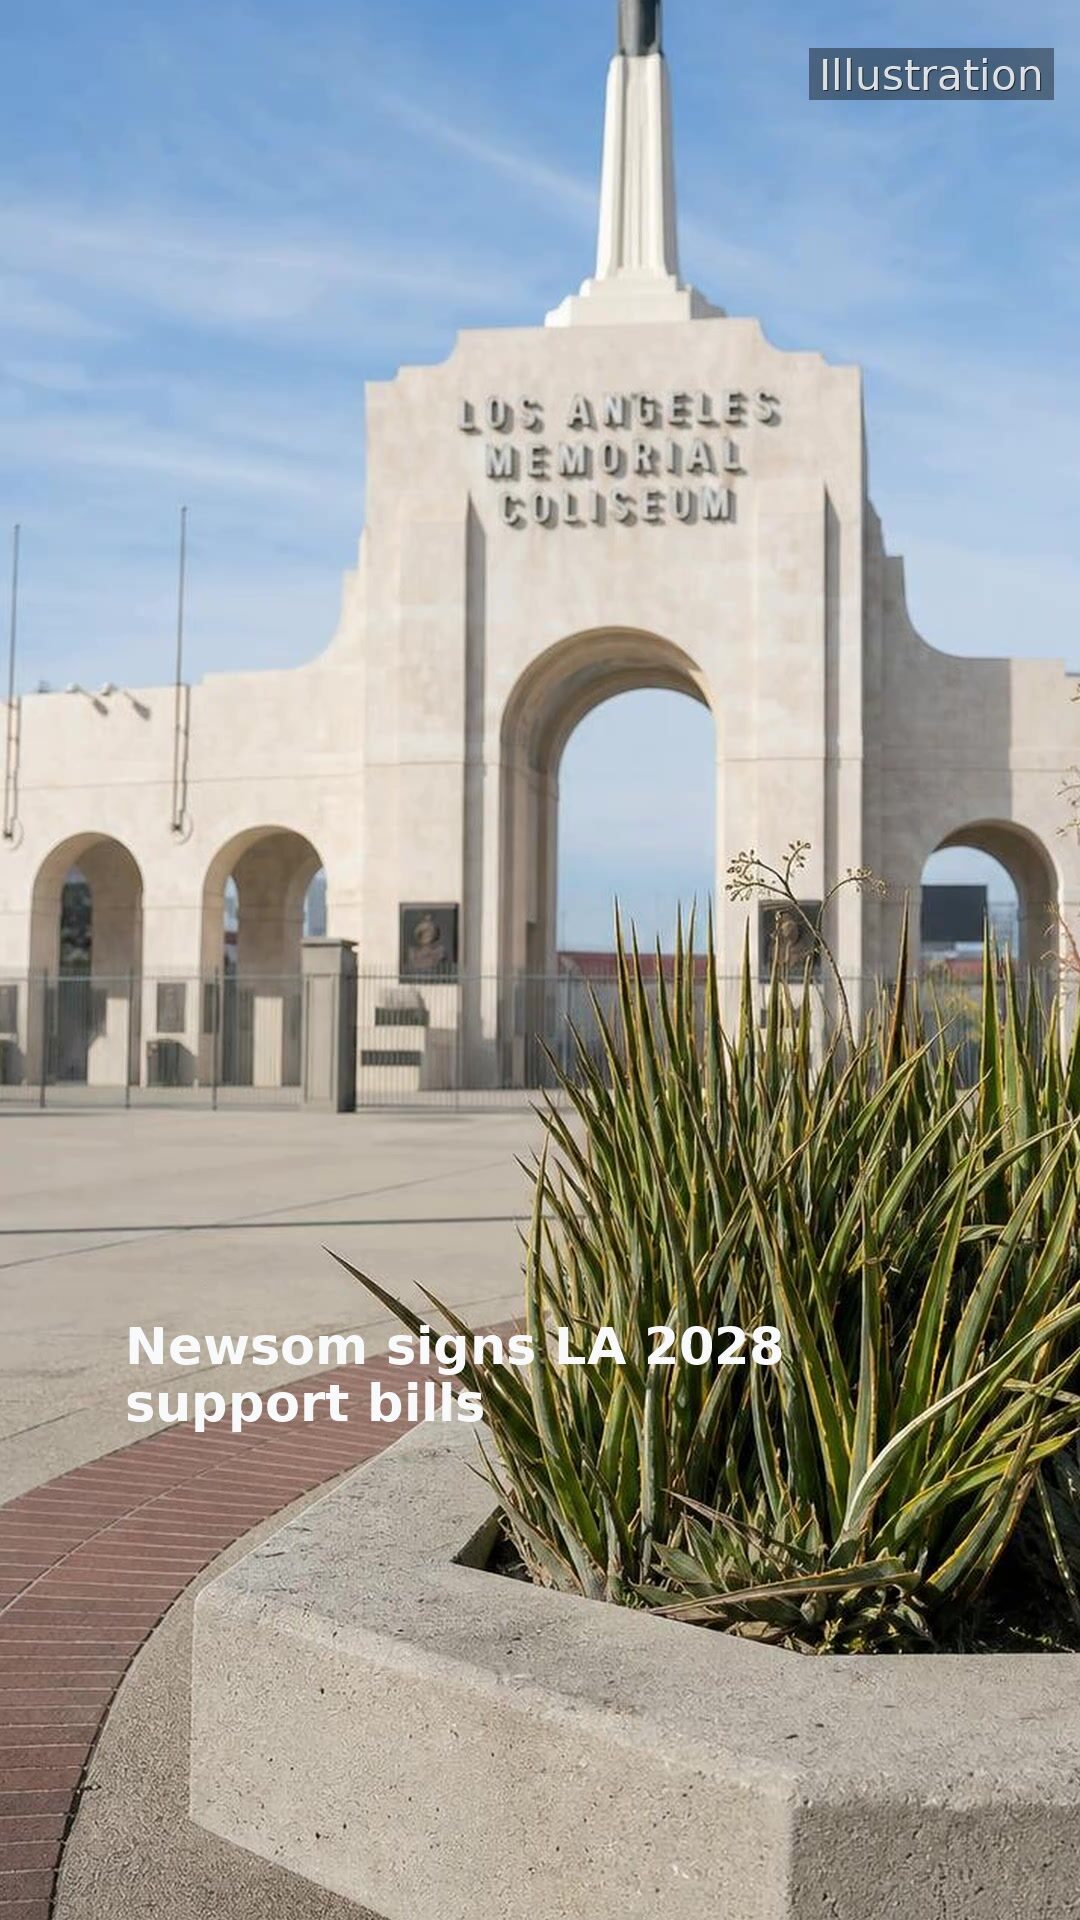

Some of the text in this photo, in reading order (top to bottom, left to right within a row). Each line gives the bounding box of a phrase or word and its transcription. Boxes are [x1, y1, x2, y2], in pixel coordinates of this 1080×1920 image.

[458, 390, 783, 435] LOS ANGELES
[485, 438, 747, 480] MEMORIAL
[500, 487, 737, 529] COLISEUM
